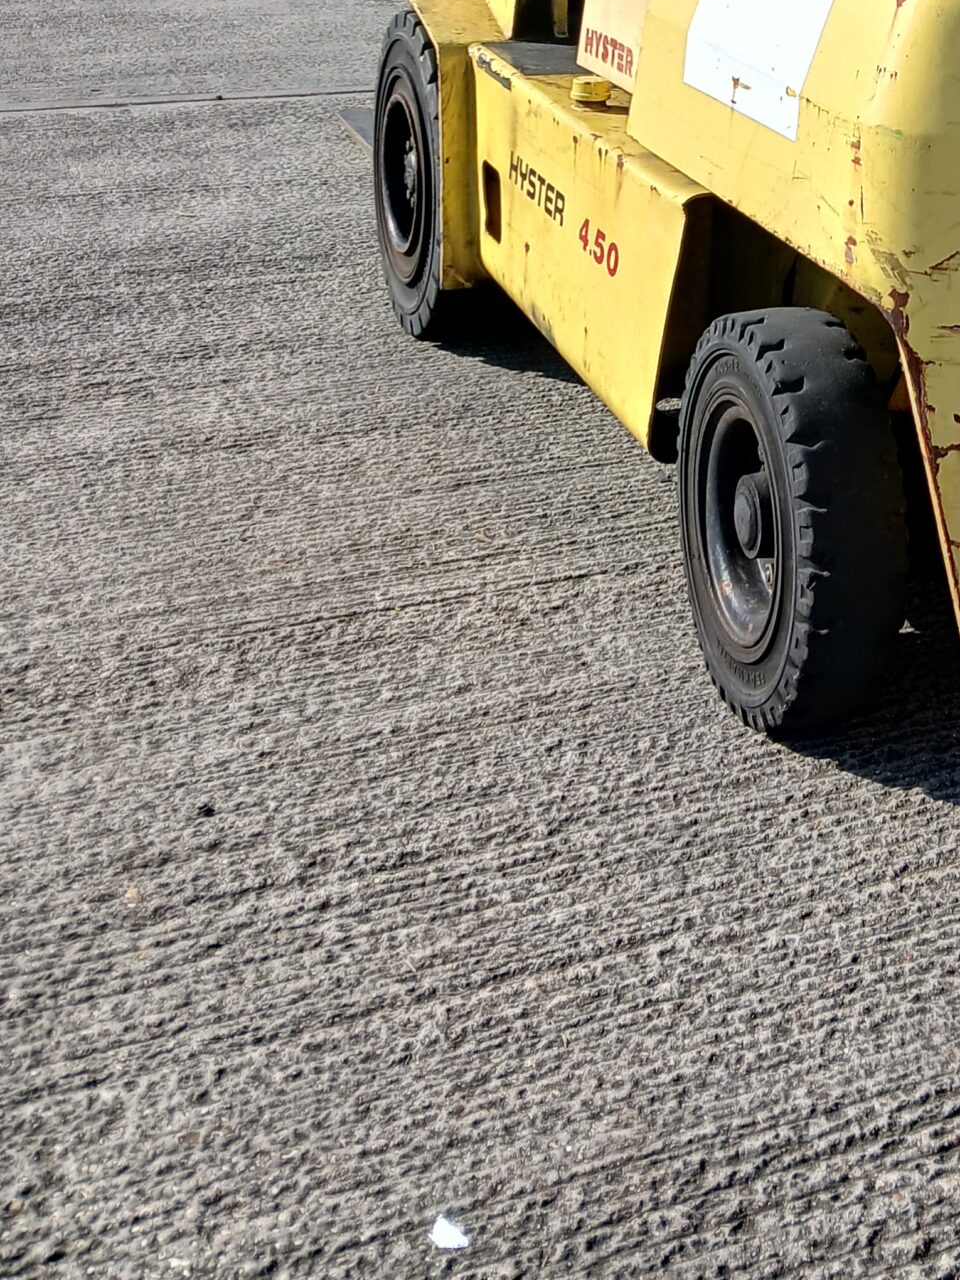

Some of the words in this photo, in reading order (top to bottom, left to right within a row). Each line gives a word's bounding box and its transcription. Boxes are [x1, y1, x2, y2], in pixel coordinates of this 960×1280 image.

[584, 27, 634, 78] HYSTER
[508, 150, 565, 227] HYSTER
[578, 218, 619, 277] 4.50
